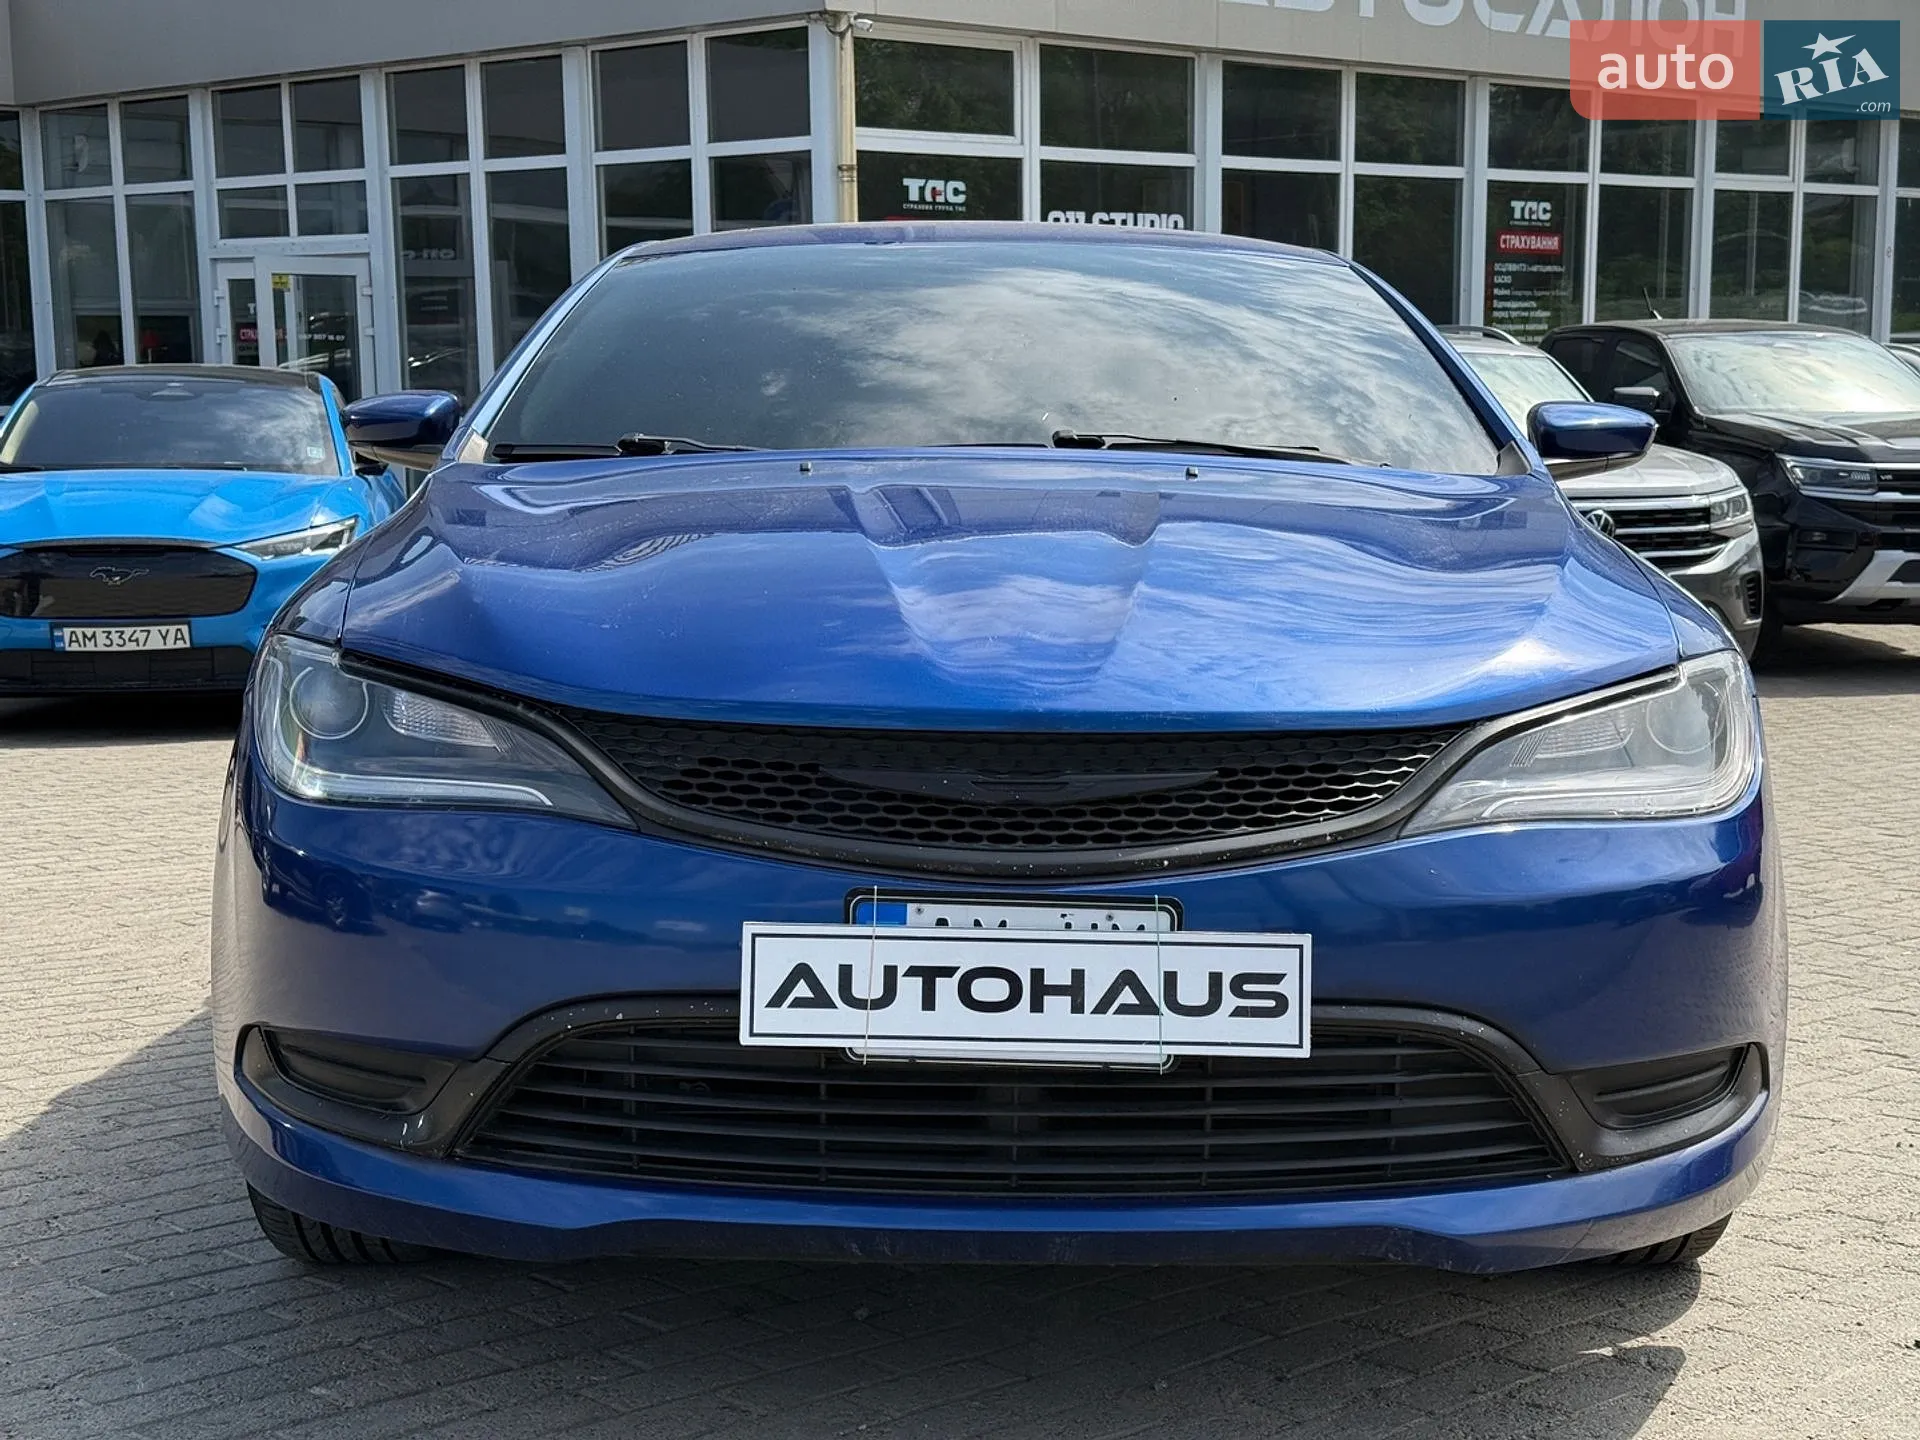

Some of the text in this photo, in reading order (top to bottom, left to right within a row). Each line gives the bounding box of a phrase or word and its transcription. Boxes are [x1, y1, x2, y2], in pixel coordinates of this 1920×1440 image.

[1500, 235, 1560, 250] СТРАХУВАННЯ
[68, 627, 187, 648] AM 3347 YA
[764, 962, 1289, 1019] AUTOHAUS
